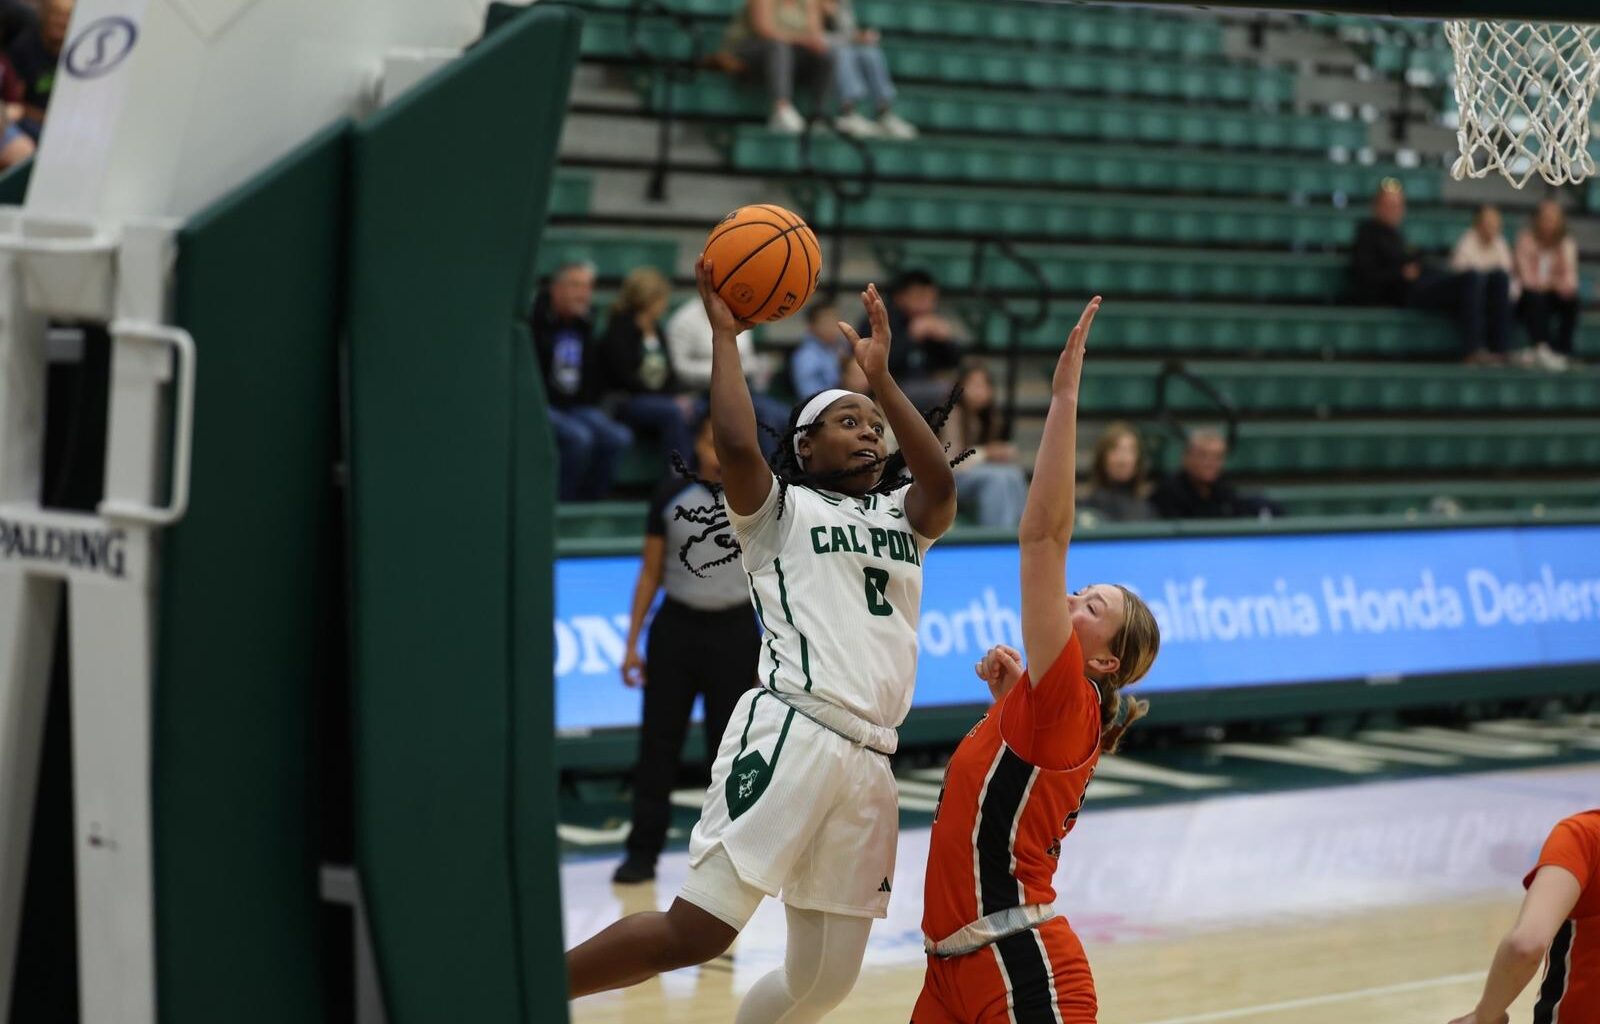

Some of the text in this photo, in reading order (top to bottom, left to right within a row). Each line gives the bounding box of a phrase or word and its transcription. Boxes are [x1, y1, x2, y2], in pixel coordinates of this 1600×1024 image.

[810, 524, 867, 554] CAL
[863, 566, 893, 616] 0
[918, 588, 1022, 655] orth
[1151, 574, 1318, 645] alifornia
[1321, 567, 1463, 635] Honda
